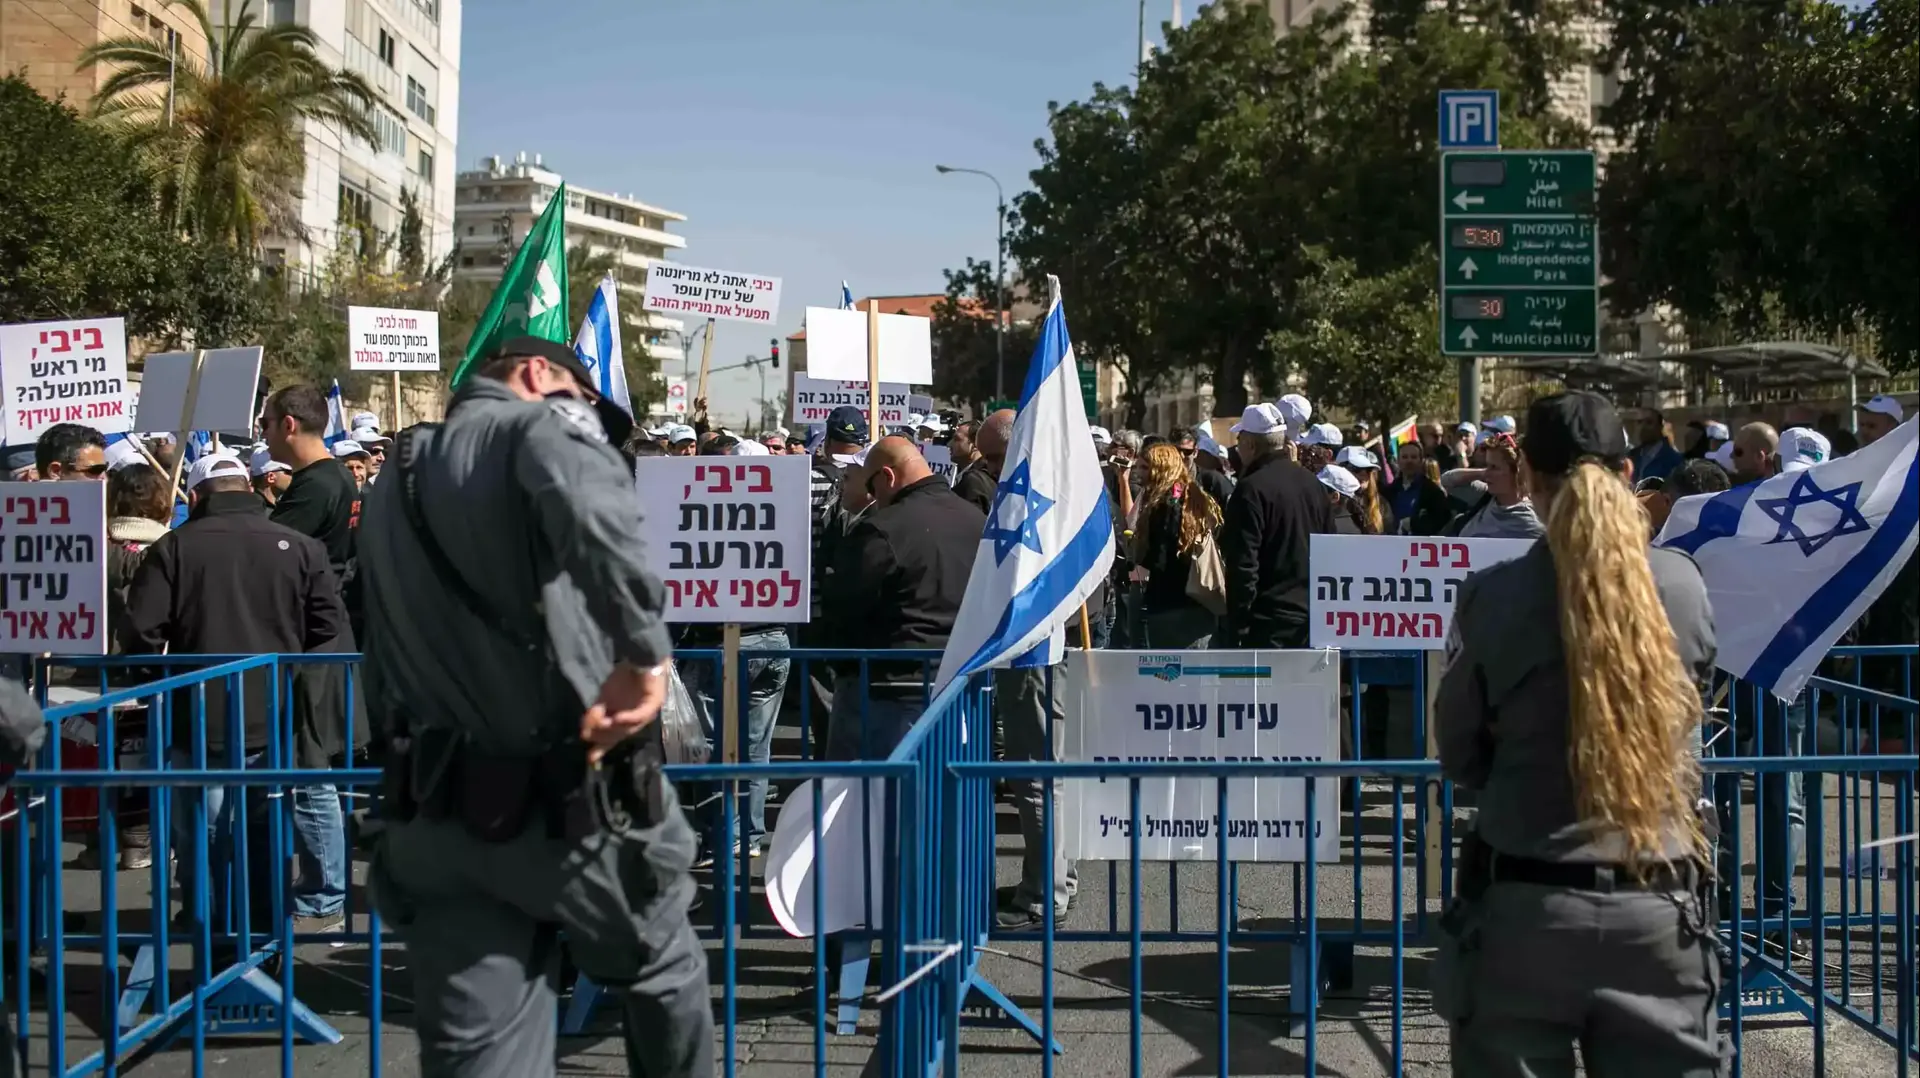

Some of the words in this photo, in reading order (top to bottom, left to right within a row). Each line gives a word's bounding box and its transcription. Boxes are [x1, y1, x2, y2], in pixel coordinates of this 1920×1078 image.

[1528, 158, 1561, 173] הלל
[1526, 196, 1563, 208] Hilel
[1512, 223, 1575, 235] העצמאות
[1497, 254, 1591, 267] Independence
[656, 266, 701, 281] מריונטה
[703, 270, 720, 284] לא
[722, 275, 748, 288] אתה
[1534, 269, 1567, 281] Park
[672, 283, 702, 297] עופר
[704, 287, 731, 301] עידן
[734, 288, 754, 303] של
[651, 296, 679, 309] הזהב
[682, 299, 712, 313] מניית
[715, 303, 732, 316] את
[1480, 300, 1501, 317] 30
[1524, 297, 1567, 310] עיריה
[735, 304, 770, 320] תפעיל
[398, 318, 417, 330] תודה
[31, 327, 104, 360] ביבי,
[364, 333, 378, 345] עוד
[380, 333, 400, 346] נוספו
[402, 334, 428, 349] בזכותך
[1491, 333, 1592, 348] Municipality
[355, 347, 383, 363] בהולנד
[417, 352, 437, 363] מאות
[30, 359, 78, 378] ראש
[85, 356, 106, 373] מי
[16, 378, 121, 403] הממשלה?
[798, 392, 816, 404] זה
[819, 392, 851, 406] בנגב
[65, 404, 83, 421] או
[87, 400, 123, 418] אתה
[17, 406, 61, 430] עידן?
[684, 465, 773, 500] ביבי,
[678, 503, 776, 531] נמות
[14, 534, 94, 563] האיום
[669, 540, 784, 570] מרעב
[1402, 542, 1471, 573] ביבי,
[730, 570, 802, 608] לפני
[1317, 575, 1354, 601] זה
[1363, 576, 1434, 602] בנגב
[0, 610, 49, 640] איר
[57, 602, 96, 640] לא
[1326, 611, 1443, 638] האמיתי
[1135, 703, 1207, 731] עופר
[1217, 703, 1278, 738] עידן
[1146, 814, 1209, 838] שהתחיל
[1261, 820, 1291, 839] דבר
